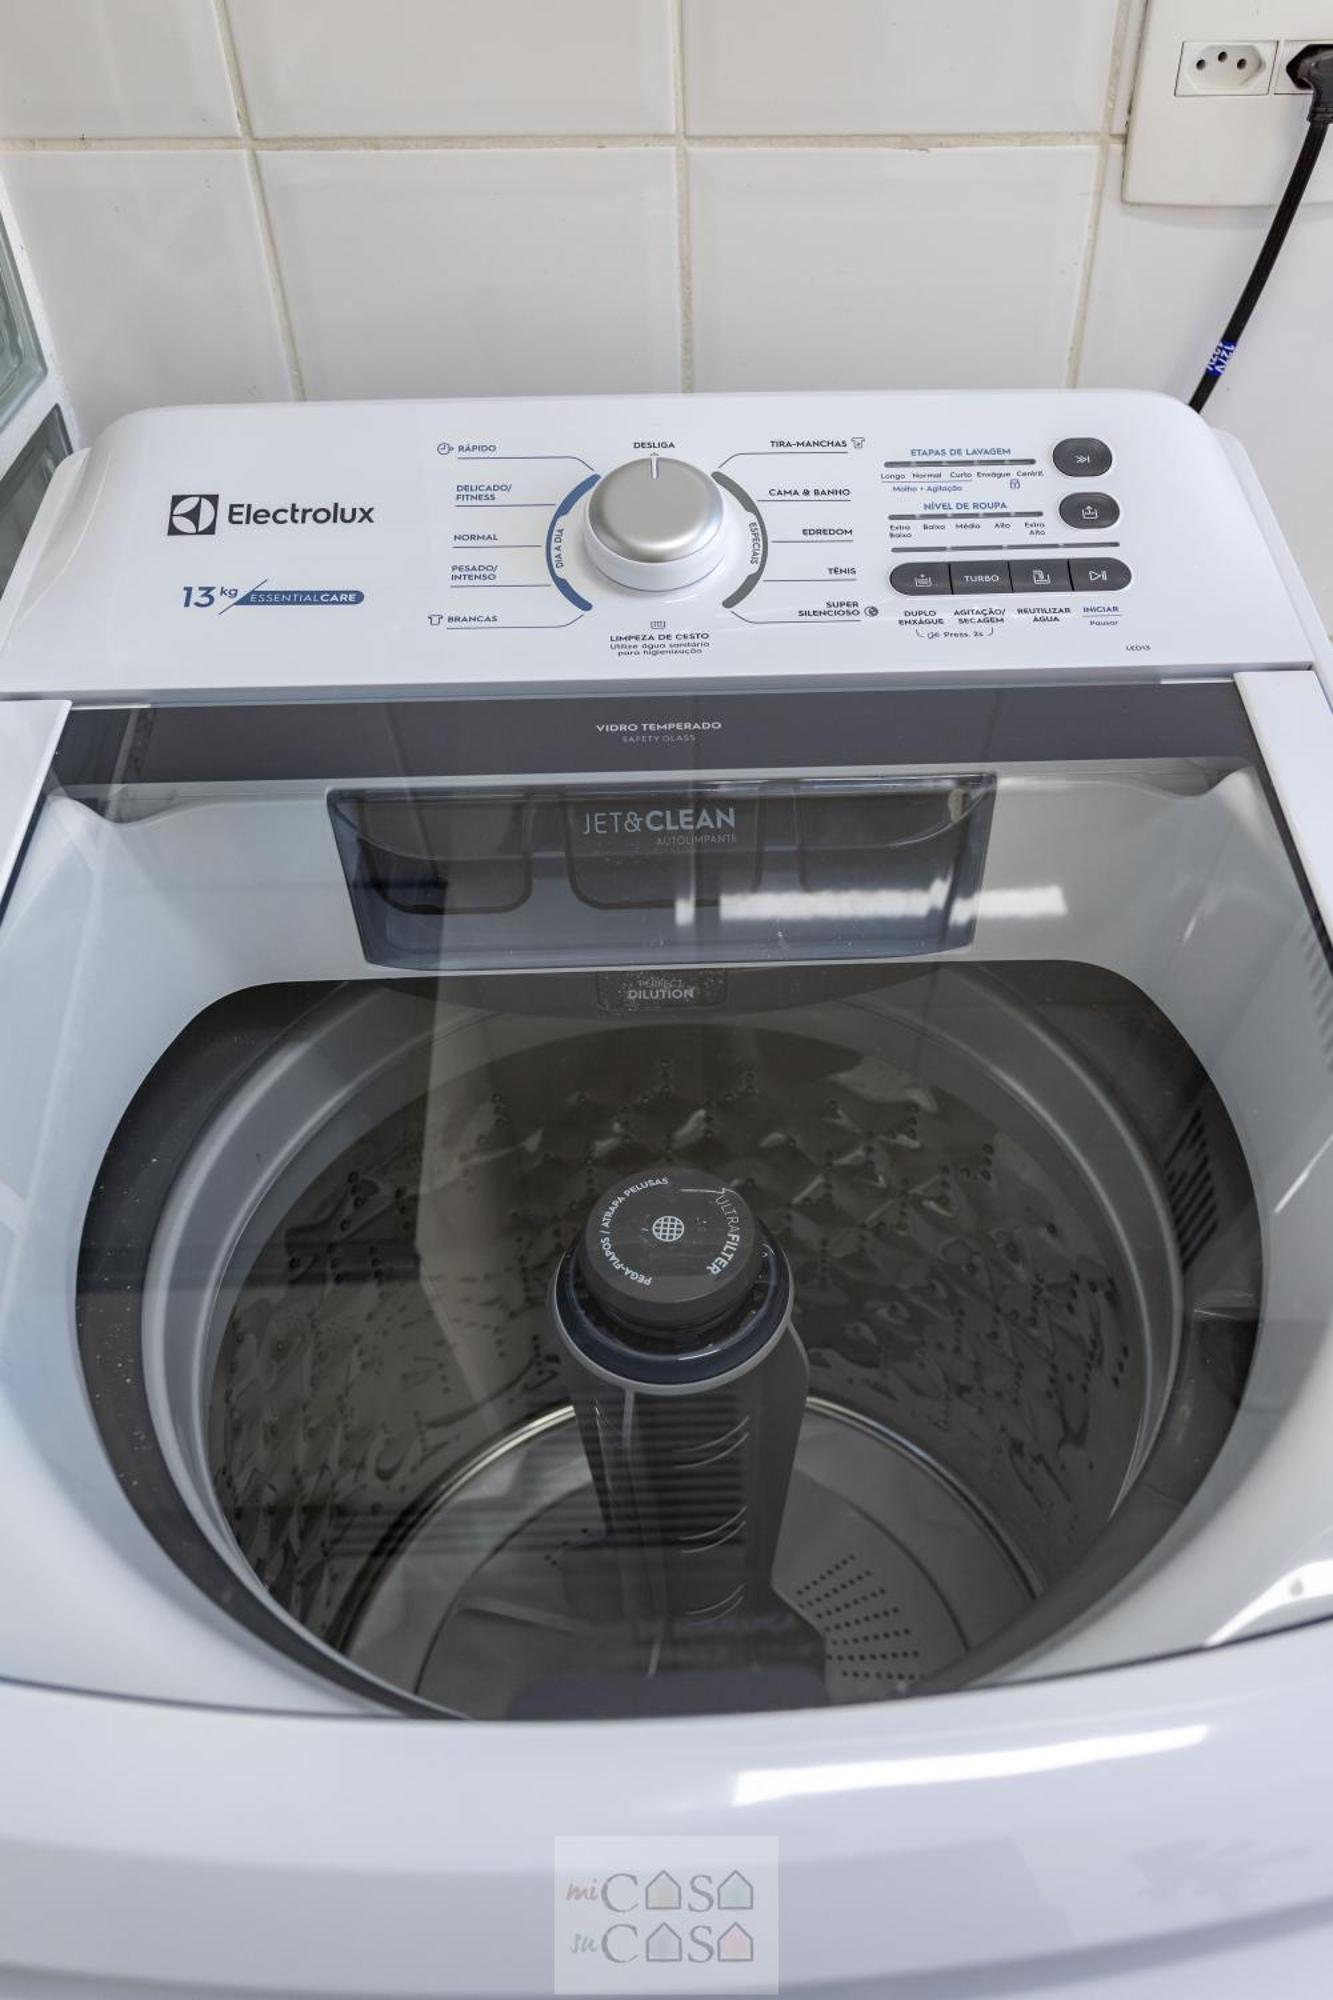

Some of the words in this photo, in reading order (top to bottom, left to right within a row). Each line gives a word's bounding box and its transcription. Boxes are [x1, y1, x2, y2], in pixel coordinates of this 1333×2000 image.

[457, 443, 497, 453] RÁPIDO
[632, 441, 676, 449] DESLIGA
[770, 440, 848, 448] TIRA-MANCHAS
[910, 449, 946, 457] ETAPAS
[949, 448, 963, 456] DE
[966, 447, 1012, 456] LAVAGEM
[456, 484, 513, 492] DELICADO/
[768, 489, 800, 497] CAMA
[802, 489, 811, 497] &
[813, 488, 851, 496] BANHO
[892, 484, 918, 492] Molho
[926, 484, 963, 493] Agitação
[923, 502, 952, 511] NÍVEL
[955, 502, 969, 510] DE
[972, 501, 1008, 509] ROUPA
[227, 503, 375, 525] Electrolux
[554, 528, 564, 544] DIA
[802, 528, 853, 536] EDREDOM
[749, 522, 761, 565] ESPECIAIS
[555, 553, 564, 569] DIA
[451, 565, 498, 573] PESADO/
[828, 567, 857, 575] TÊNIS
[451, 573, 496, 581] INTENSO
[964, 574, 1000, 583] TURBO
[182, 586, 216, 608] 13
[220, 587, 238, 598] kg
[250, 593, 356, 603] ESSENTIALCARE
[826, 601, 859, 609] SUPER
[798, 609, 861, 617] SILENCIOSO
[953, 608, 1006, 617] AGITAÇÃO/
[1017, 607, 1071, 615] REUTILIZAR
[1083, 606, 1120, 614] INICIAR
[448, 615, 498, 623] BRANCAS
[958, 617, 1005, 625] SECAGEM
[1033, 615, 1061, 623] ÁGUA
[610, 634, 655, 642] LIMPEZA
[658, 633, 672, 641] DE
[675, 632, 710, 640] CESTO
[641, 643, 666, 651] água
[643, 648, 703, 657] higienização
[596, 722, 638, 733] VIDRO
[640, 721, 722, 732] TEMPERADO
[621, 735, 660, 744] SAFETY
[662, 733, 697, 743] GLASS
[583, 807, 737, 835] JET&CLEAN
[656, 834, 738, 846] AUTOLIMPANTE
[627, 988, 695, 1000] DILUTION
[623, 1176, 670, 1197] PELUSAS
[601, 1196, 626, 1229] ATRAPA
[706, 1194, 741, 1275] ULTRAFILTER
[600, 1236, 652, 1287] PEGA-FIAPOS
